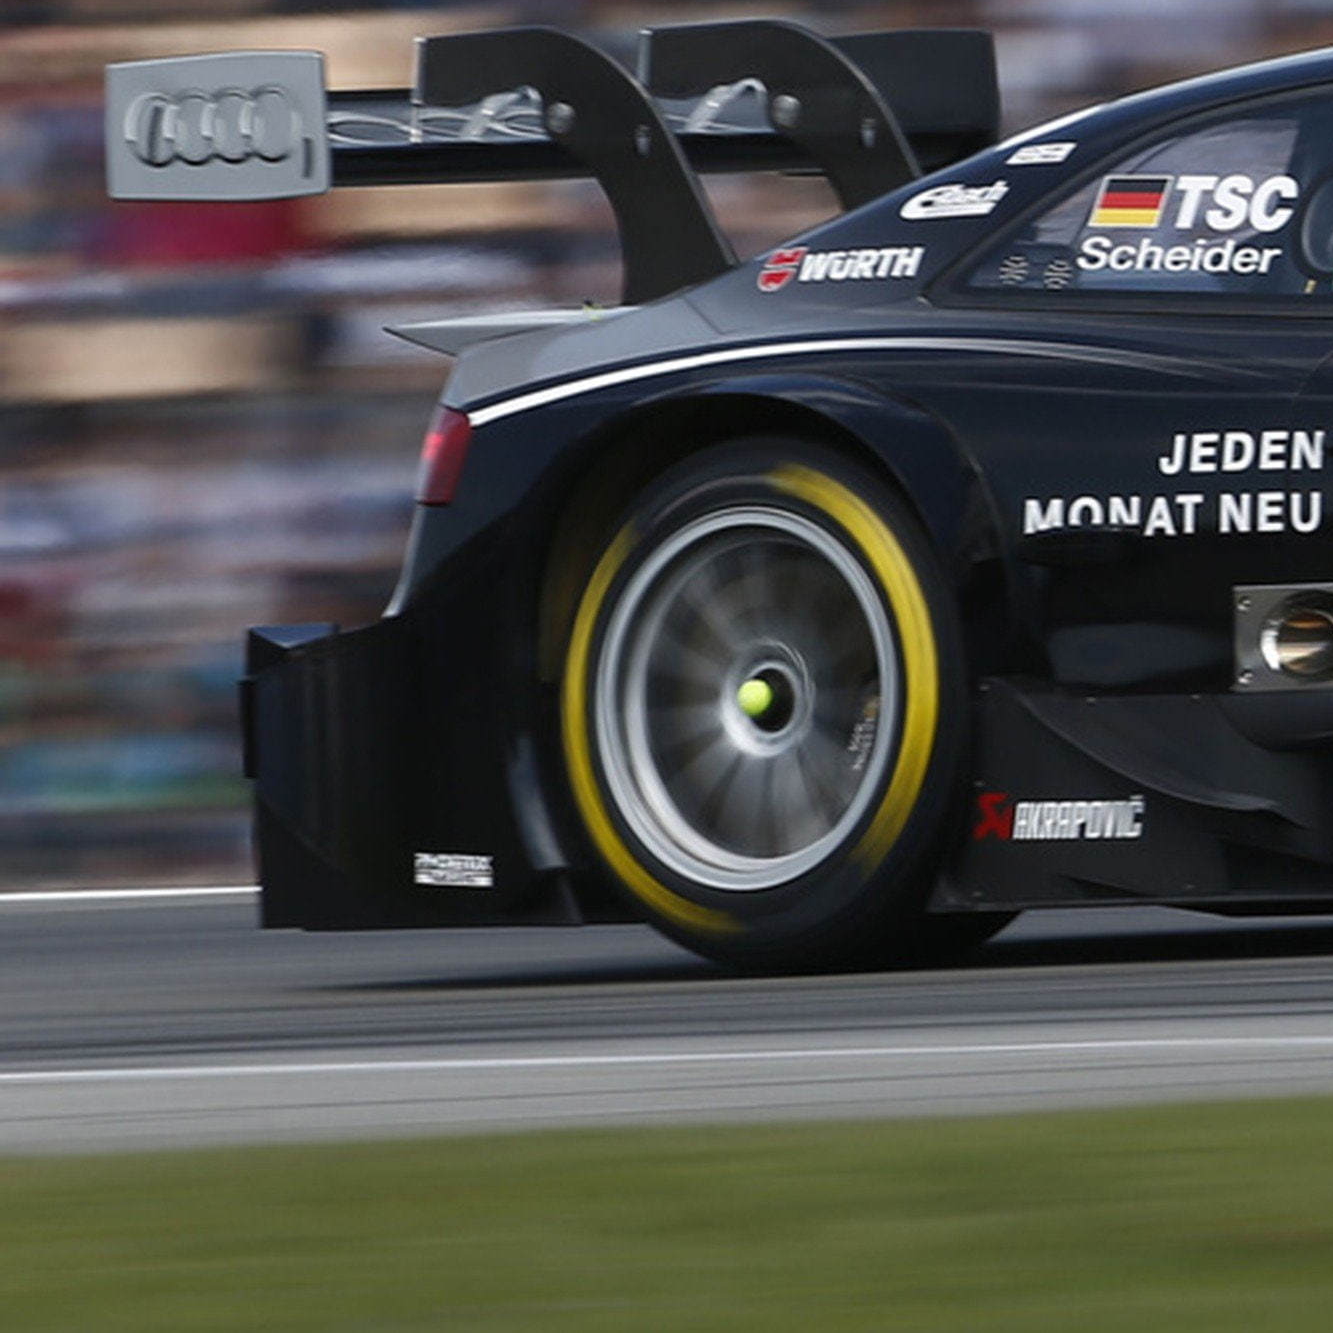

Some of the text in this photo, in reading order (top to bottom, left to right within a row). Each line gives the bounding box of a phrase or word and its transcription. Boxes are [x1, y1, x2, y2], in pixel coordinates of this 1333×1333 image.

[1175, 175, 1298, 232] TSC
[1076, 237, 1282, 274] Scheider
[1158, 431, 1326, 475] JEDEN
[1022, 492, 1322, 537] MONAT NEU
